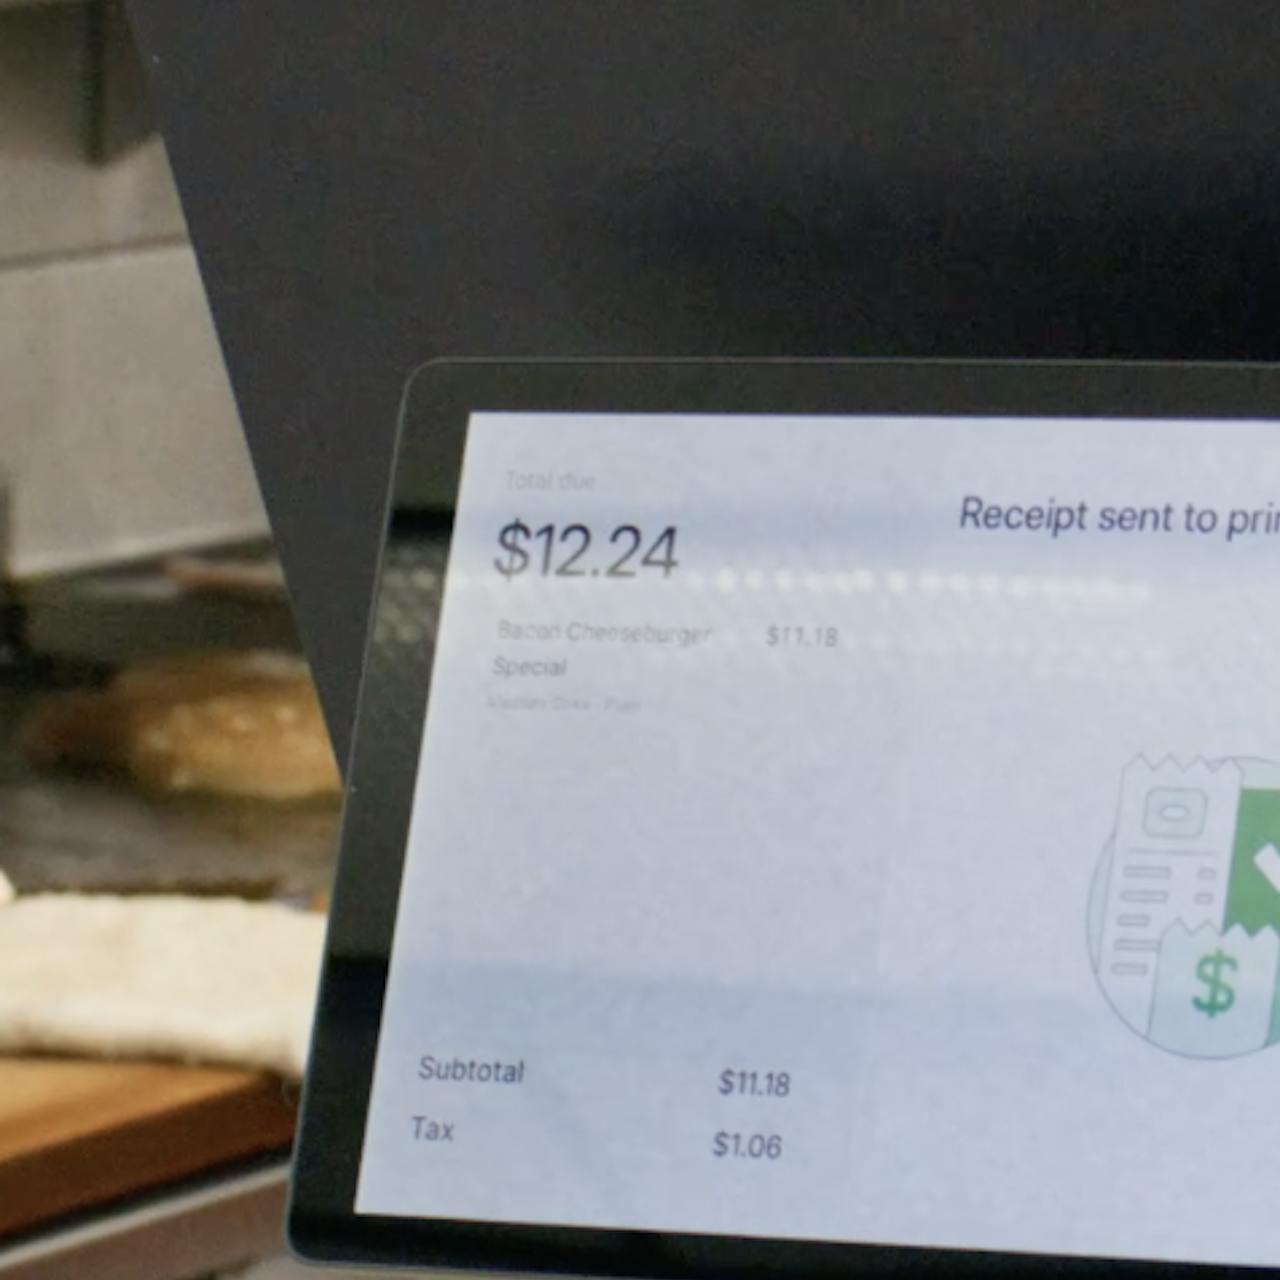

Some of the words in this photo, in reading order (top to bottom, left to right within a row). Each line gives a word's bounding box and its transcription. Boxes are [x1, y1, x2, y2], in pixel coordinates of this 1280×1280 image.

[507, 470, 550, 491] Total
[556, 471, 596, 491] due
[959, 495, 1088, 539] Receipt
[1097, 502, 1174, 533] sent
[1184, 503, 1219, 534] to
[493, 517, 679, 582] $12.24
[497, 618, 561, 641] Bacon
[565, 621, 713, 648] Cheeseburger
[766, 623, 839, 648] $11.18
[491, 656, 568, 678] Special
[418, 1055, 526, 1084] Subtotal
[717, 1068, 792, 1098] $11.18
[410, 1115, 456, 1142] Tax
[711, 1131, 783, 1160] $1.06
